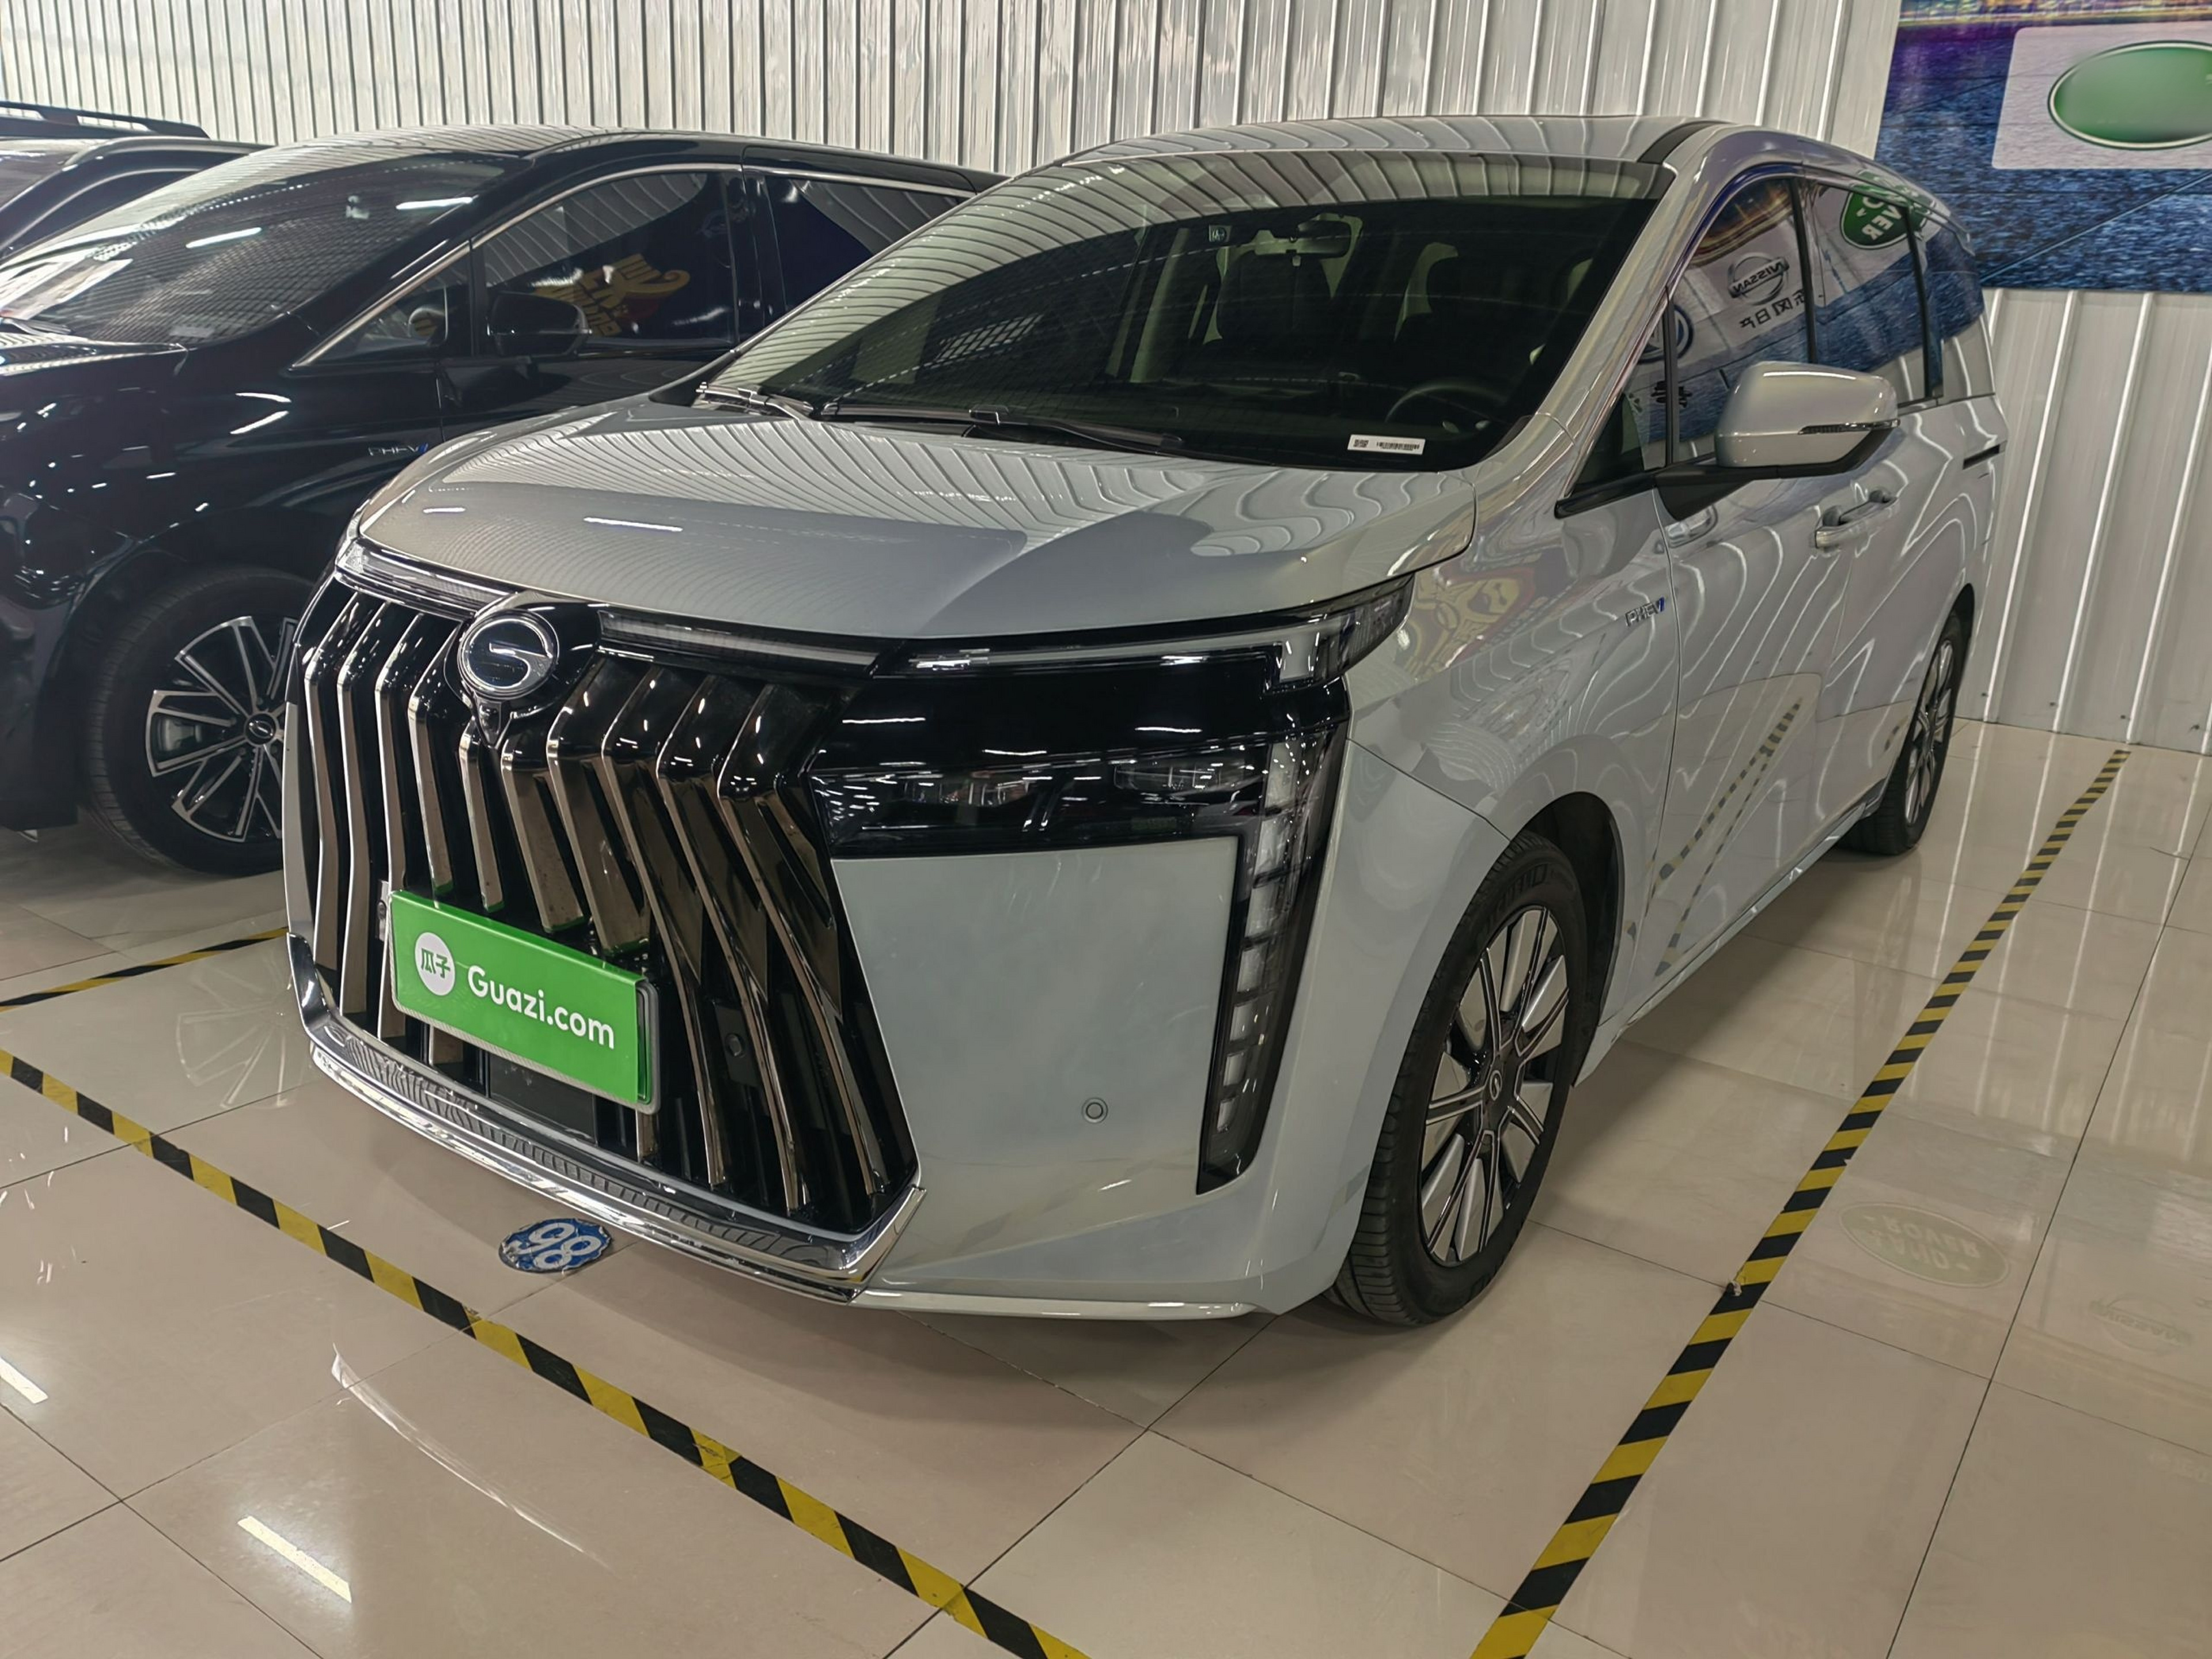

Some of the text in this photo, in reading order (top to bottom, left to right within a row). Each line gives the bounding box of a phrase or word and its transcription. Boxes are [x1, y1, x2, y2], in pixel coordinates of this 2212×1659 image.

[1625, 596, 1665, 627] PHEV
[421, 948, 451, 979] 瓜子
[467, 965, 615, 1050] Guazi.com
